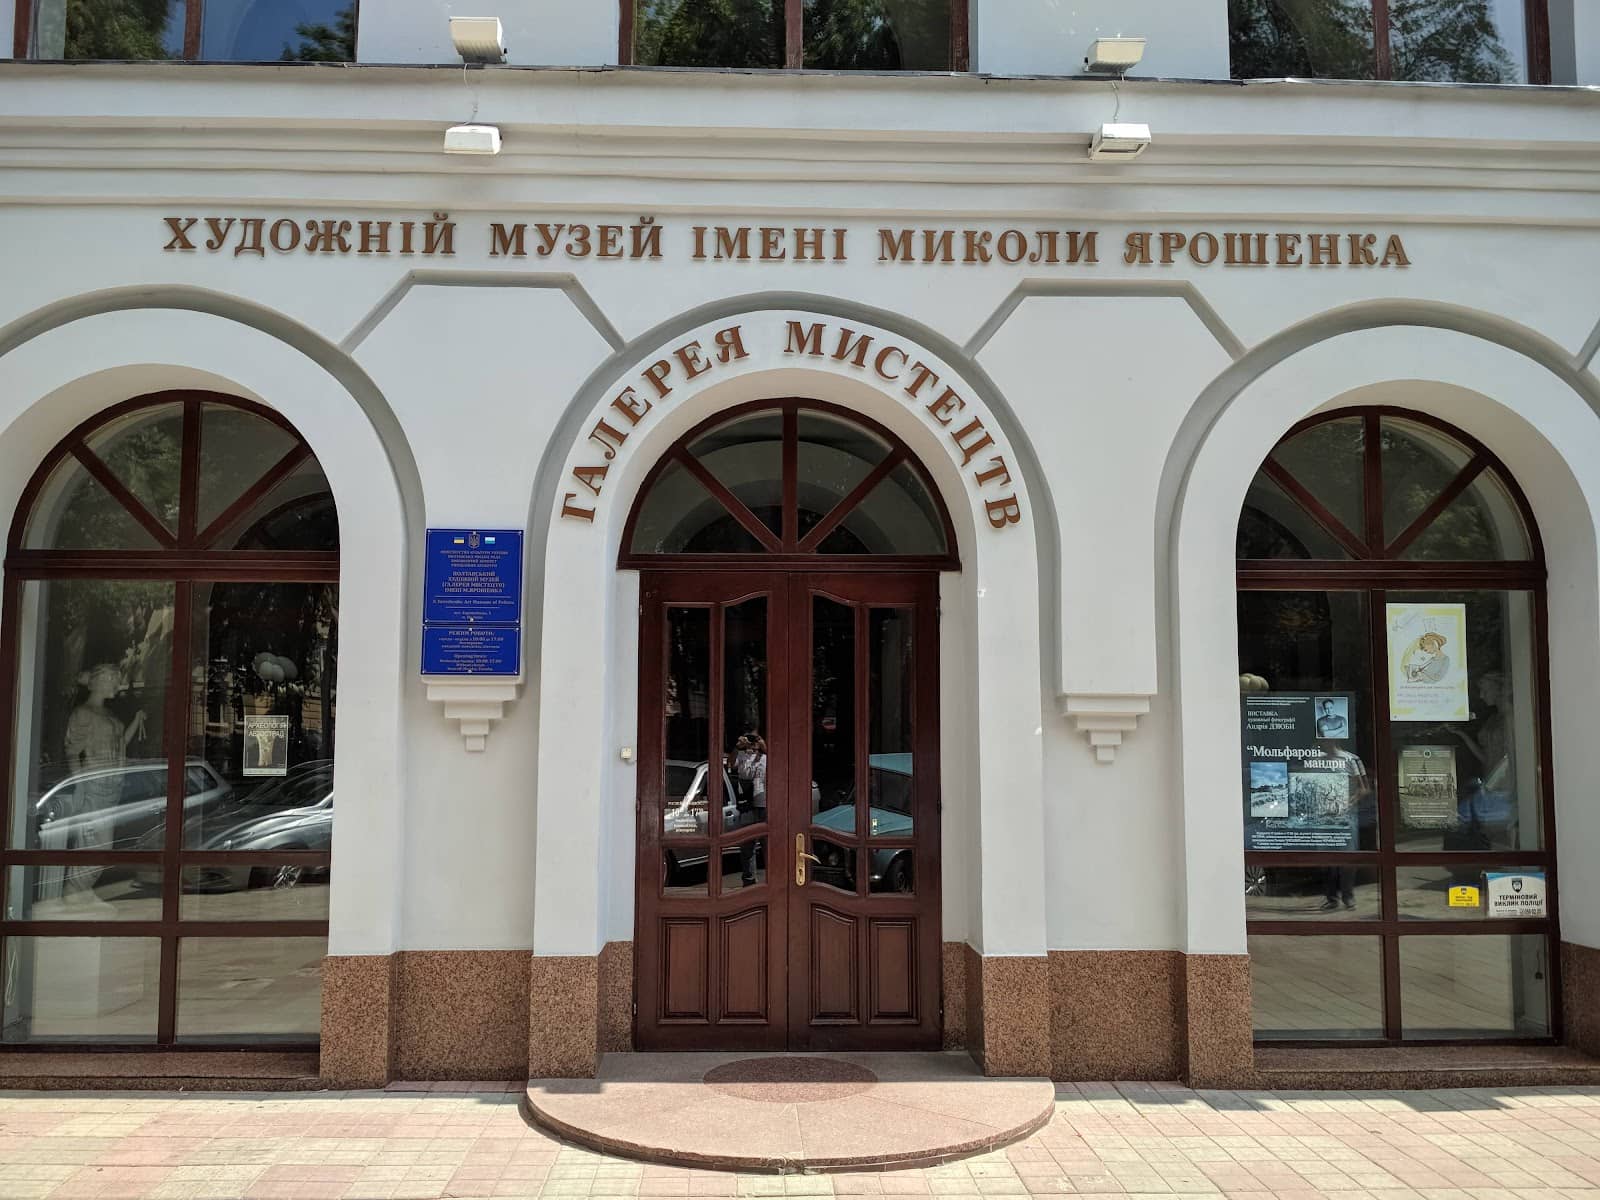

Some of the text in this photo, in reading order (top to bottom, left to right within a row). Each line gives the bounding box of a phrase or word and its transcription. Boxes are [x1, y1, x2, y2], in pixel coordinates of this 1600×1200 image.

[163, 211, 1411, 269] ХУДОЖНІЙ МУЗЕЙ ІМЕНІ МИКОЛИ ЯРОШЕНКА
[560, 320, 1022, 530] ГАЛЕРЕЯ МИСТЕЦТВ
